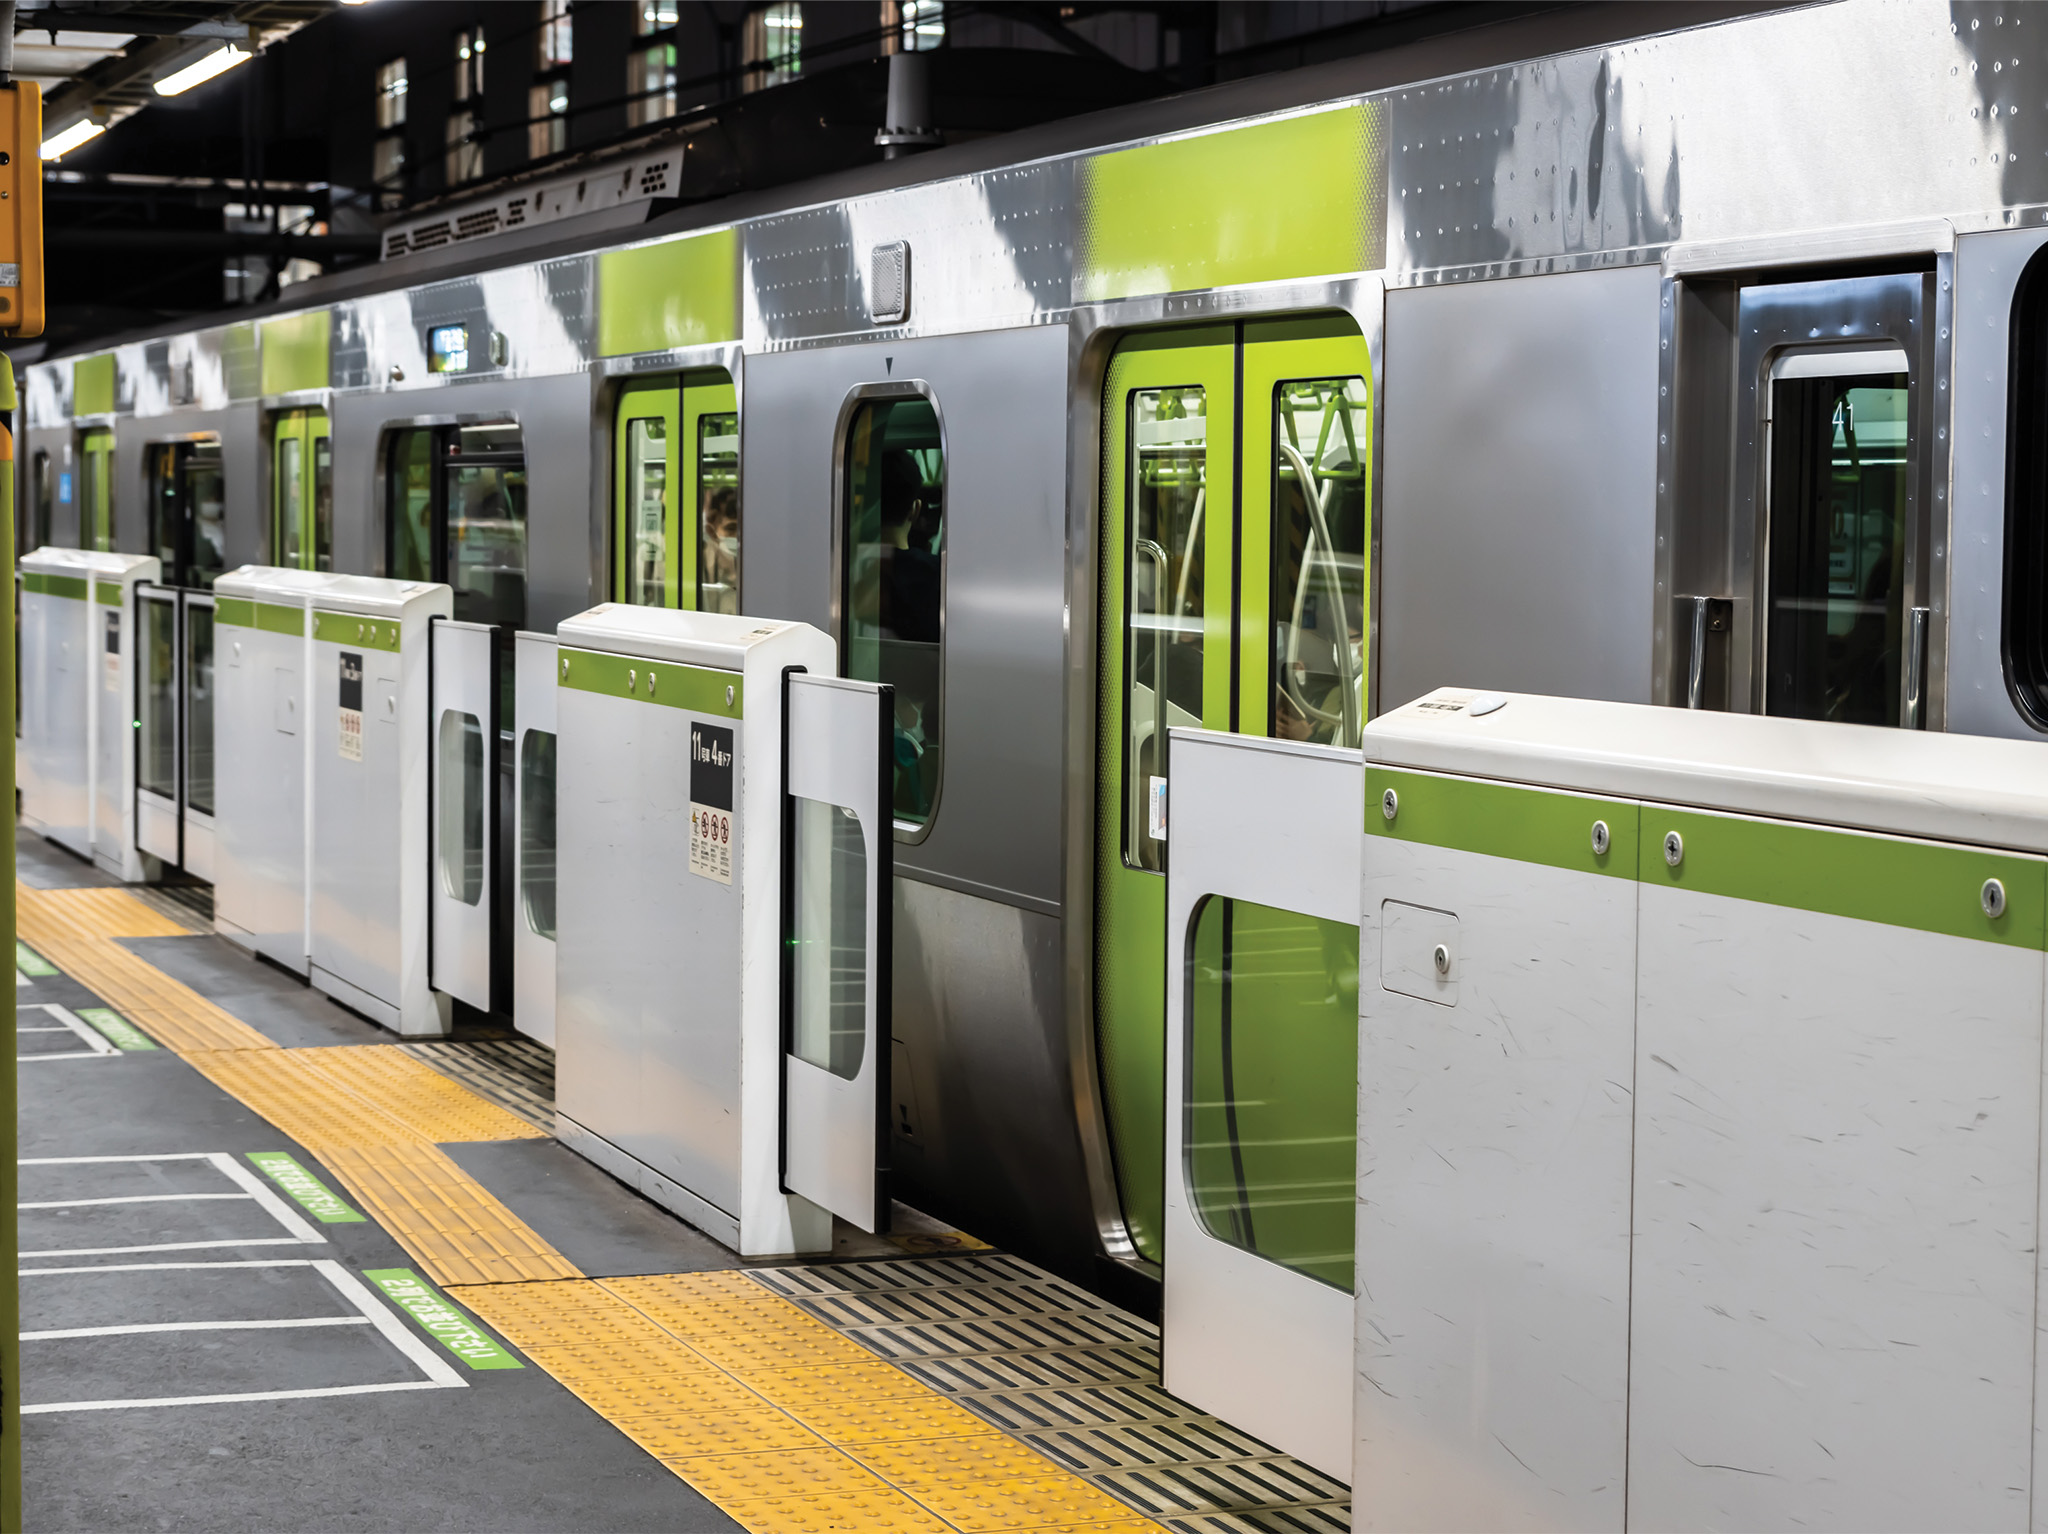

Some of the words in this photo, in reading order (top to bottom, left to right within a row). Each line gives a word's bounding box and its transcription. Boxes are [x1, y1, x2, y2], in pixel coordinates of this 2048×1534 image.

[1832, 401, 1854, 431] 41
[380, 1278, 499, 1359] 2列でお並び下さい
